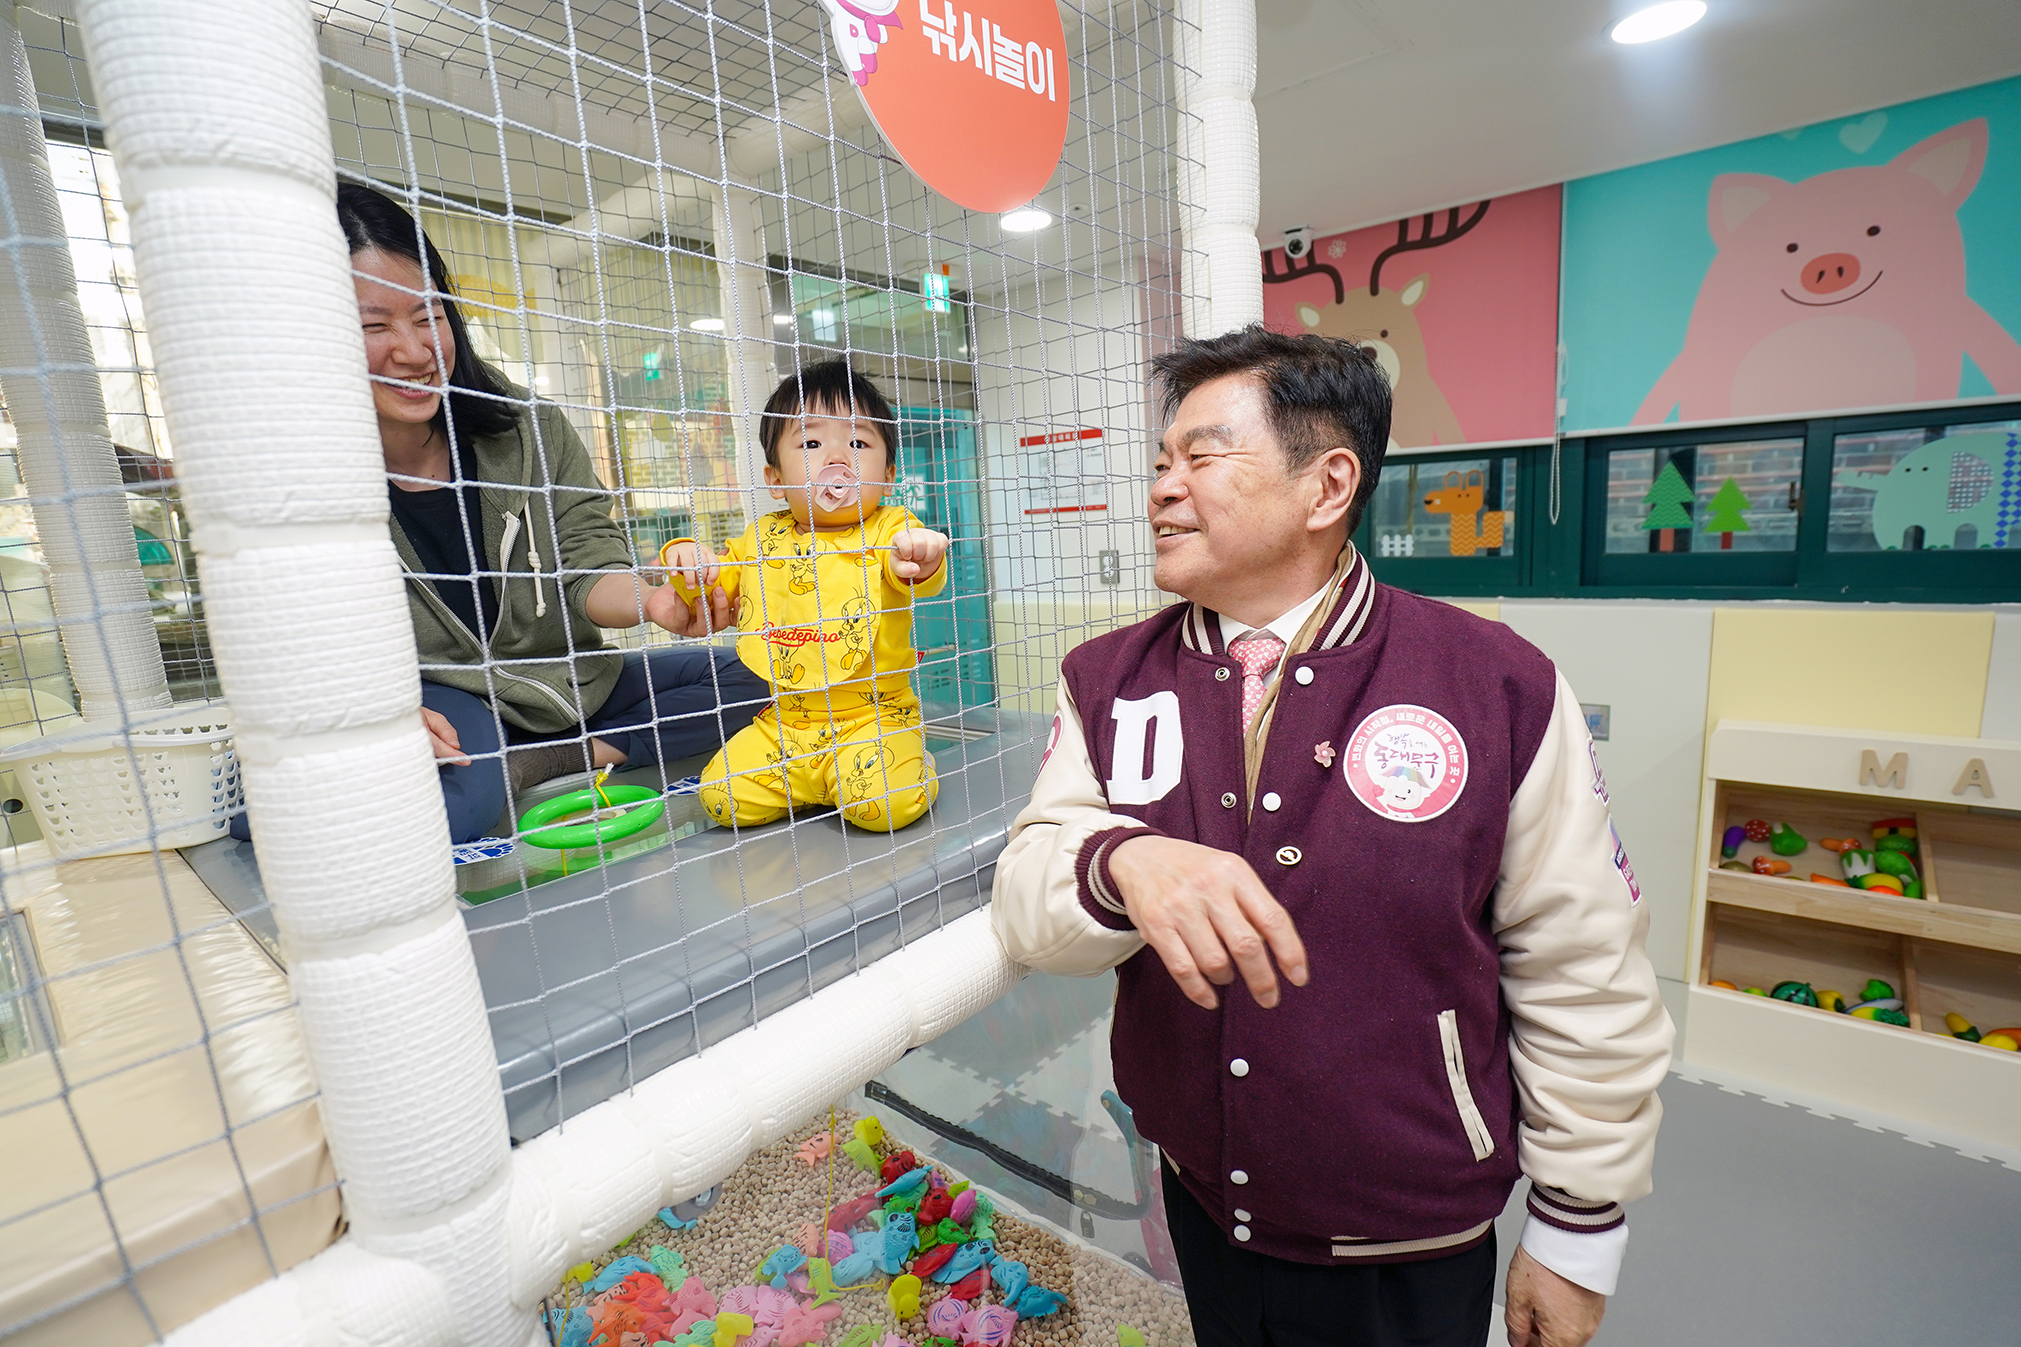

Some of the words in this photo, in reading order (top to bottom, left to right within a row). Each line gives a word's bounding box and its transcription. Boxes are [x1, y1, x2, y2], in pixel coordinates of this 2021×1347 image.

[919, 0, 1056, 102] 낚시놀이
[1106, 690, 1184, 806] D
[1352, 737, 1367, 761] 변화의
[1396, 712, 1426, 725] 새로운
[1426, 719, 1453, 744] 내일을
[1447, 744, 1460, 764] 여는
[1373, 740, 1440, 779] 동대문구
[1858, 748, 1910, 790] M
[1951, 757, 1996, 799] A
